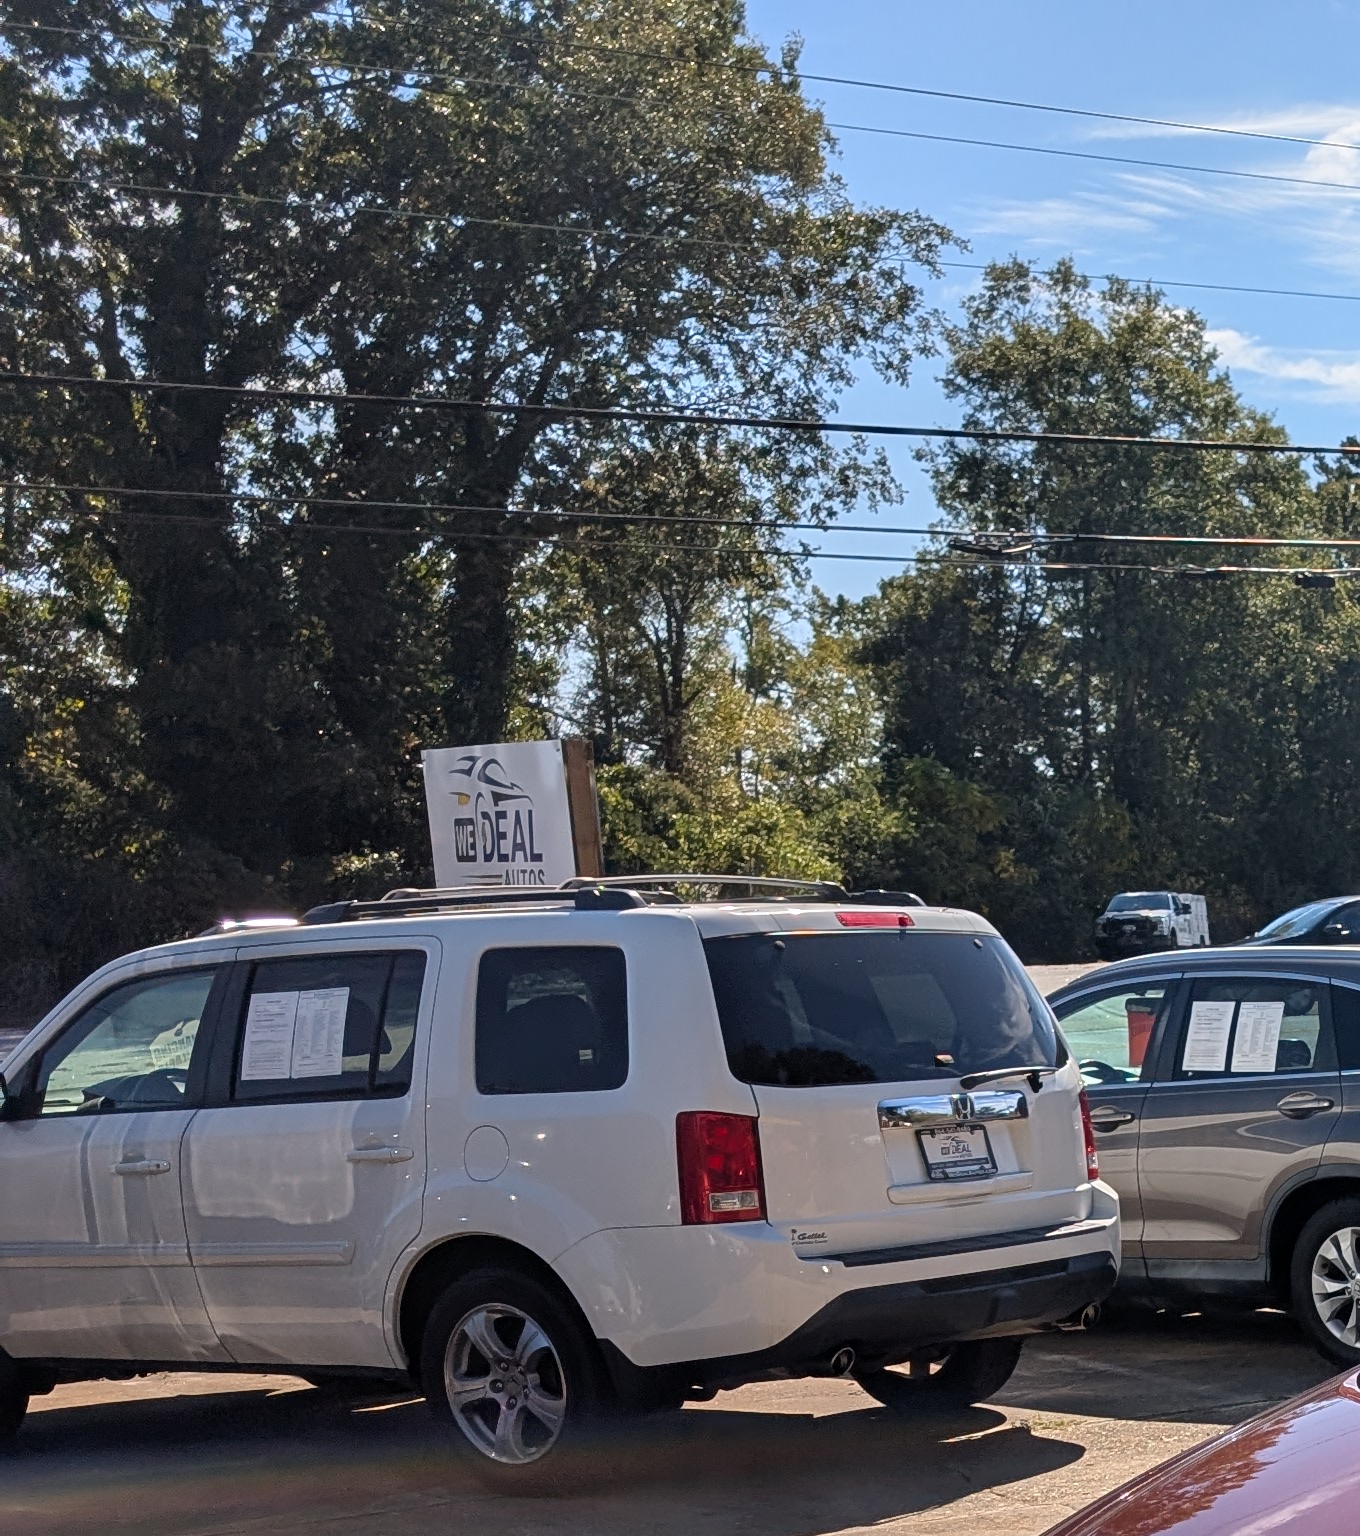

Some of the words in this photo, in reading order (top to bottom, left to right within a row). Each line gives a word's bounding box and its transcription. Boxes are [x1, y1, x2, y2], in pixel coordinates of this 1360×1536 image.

[455, 824, 476, 857] WE
[480, 809, 544, 863] DEAL
[504, 868, 546, 886] AUTOS
[951, 1143, 972, 1155] DEAL
